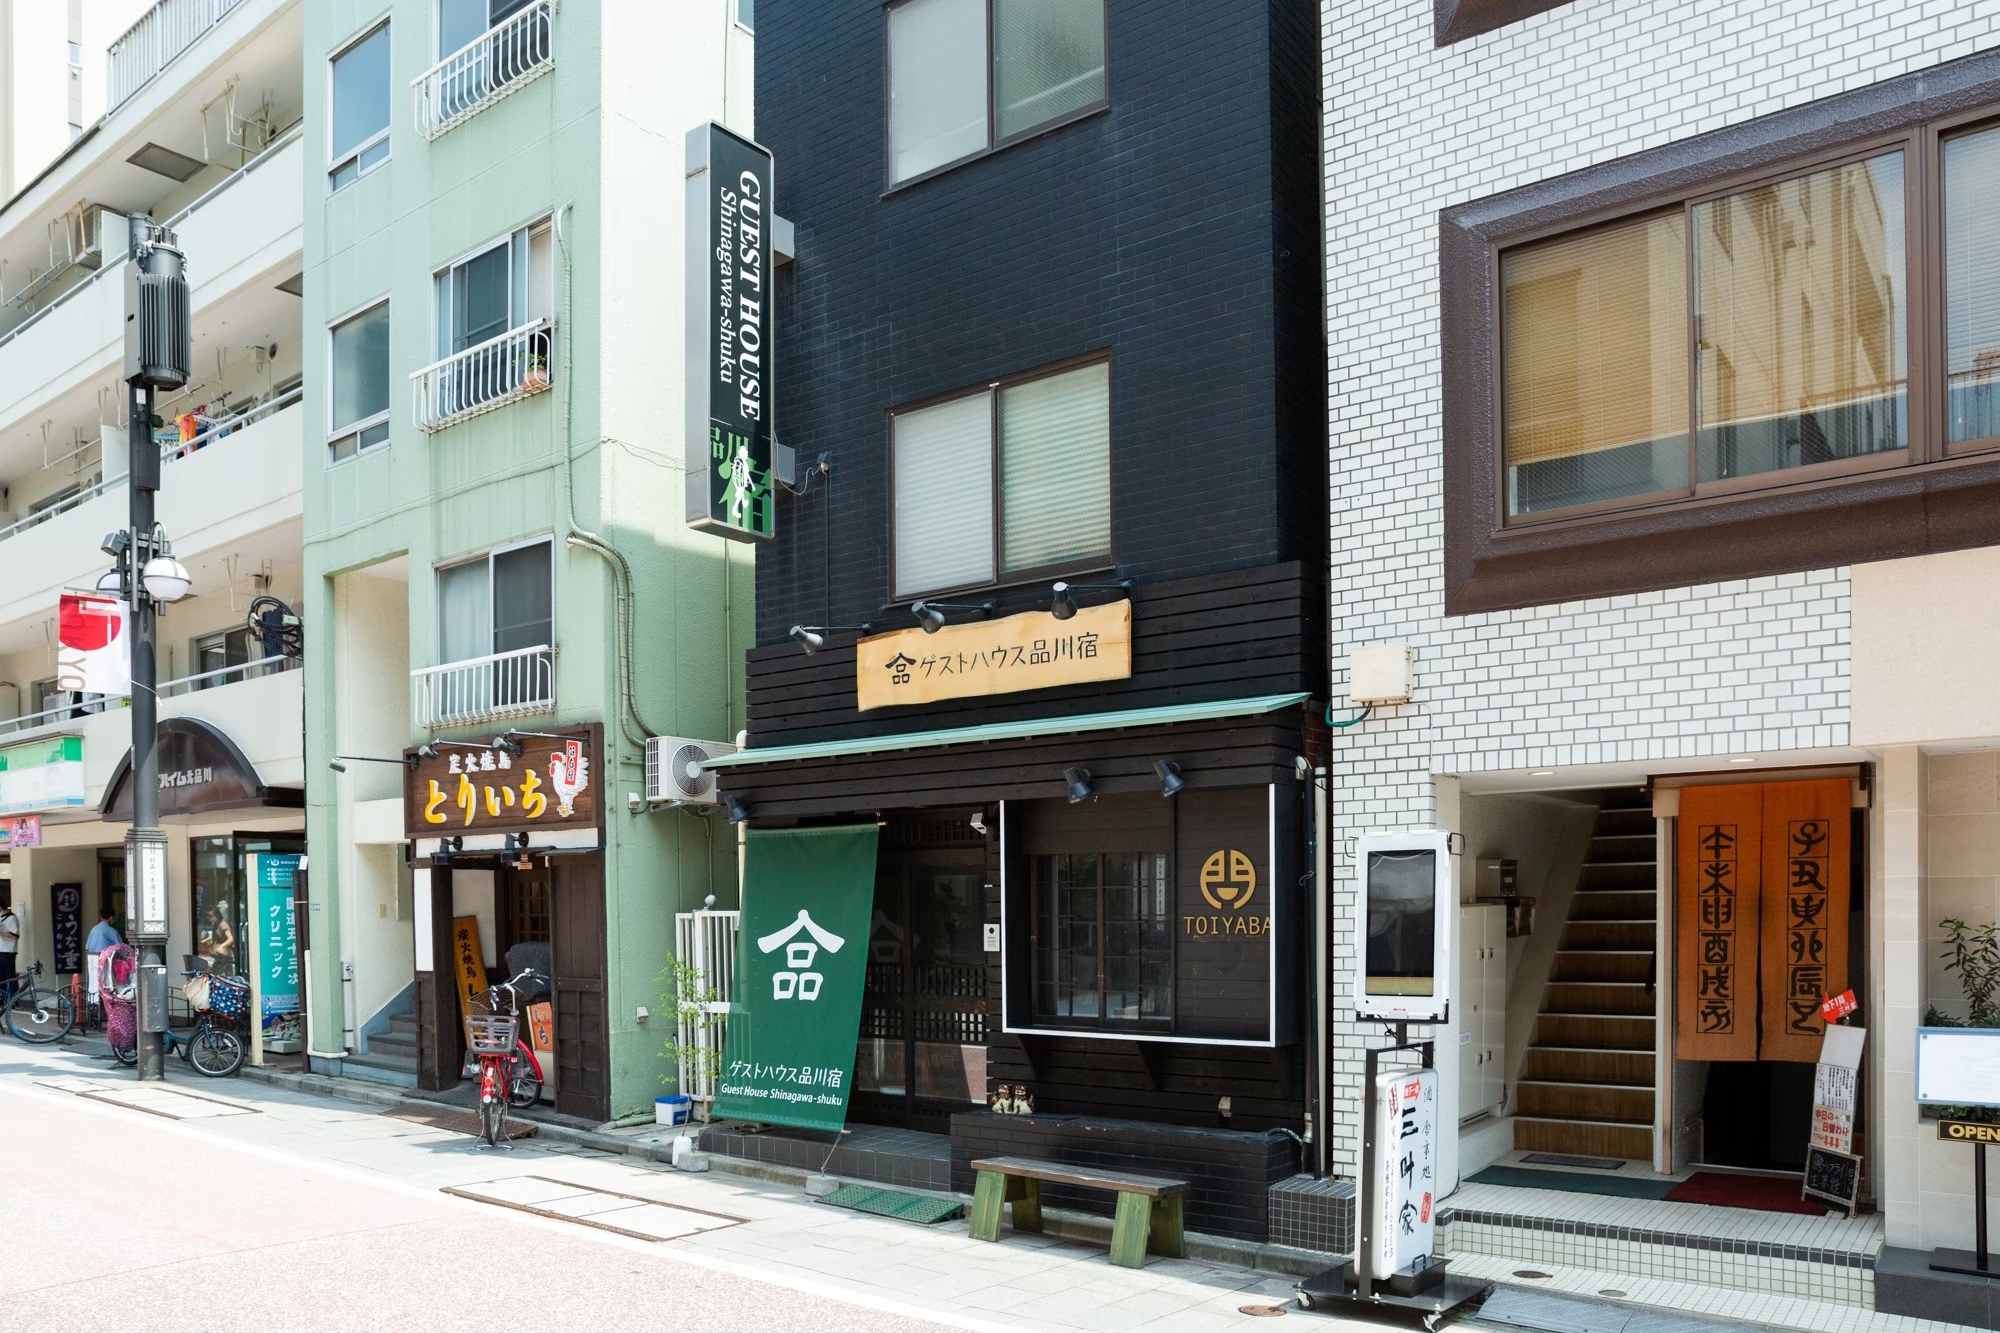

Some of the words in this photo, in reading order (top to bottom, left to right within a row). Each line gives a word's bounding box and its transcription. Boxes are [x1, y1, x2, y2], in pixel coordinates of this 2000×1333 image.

[739, 170, 761, 293] GUEST
[717, 185, 738, 385] Shinagawa-shuku
[739, 293, 761, 421] HOUSE
[919, 631, 1099, 679] ゲストハウス品川宿
[448, 750, 512, 775] 炭火焼鳥
[424, 769, 548, 827] とりいち
[61, 913, 81, 970] うな重
[269, 904, 283, 979] クリニック
[1183, 916, 1271, 935] TOIYABA
[457, 928, 477, 979] 炭火焼鳥
[721, 1083, 743, 1096] Guest
[744, 1086, 768, 1099] House
[770, 1088, 843, 1106] Shinagawa-shuku
[729, 1060, 843, 1089] ゲストハウス品川宿
[1815, 1108, 1834, 1121] 本日の
[1948, 1124, 2000, 1142] OPEN
